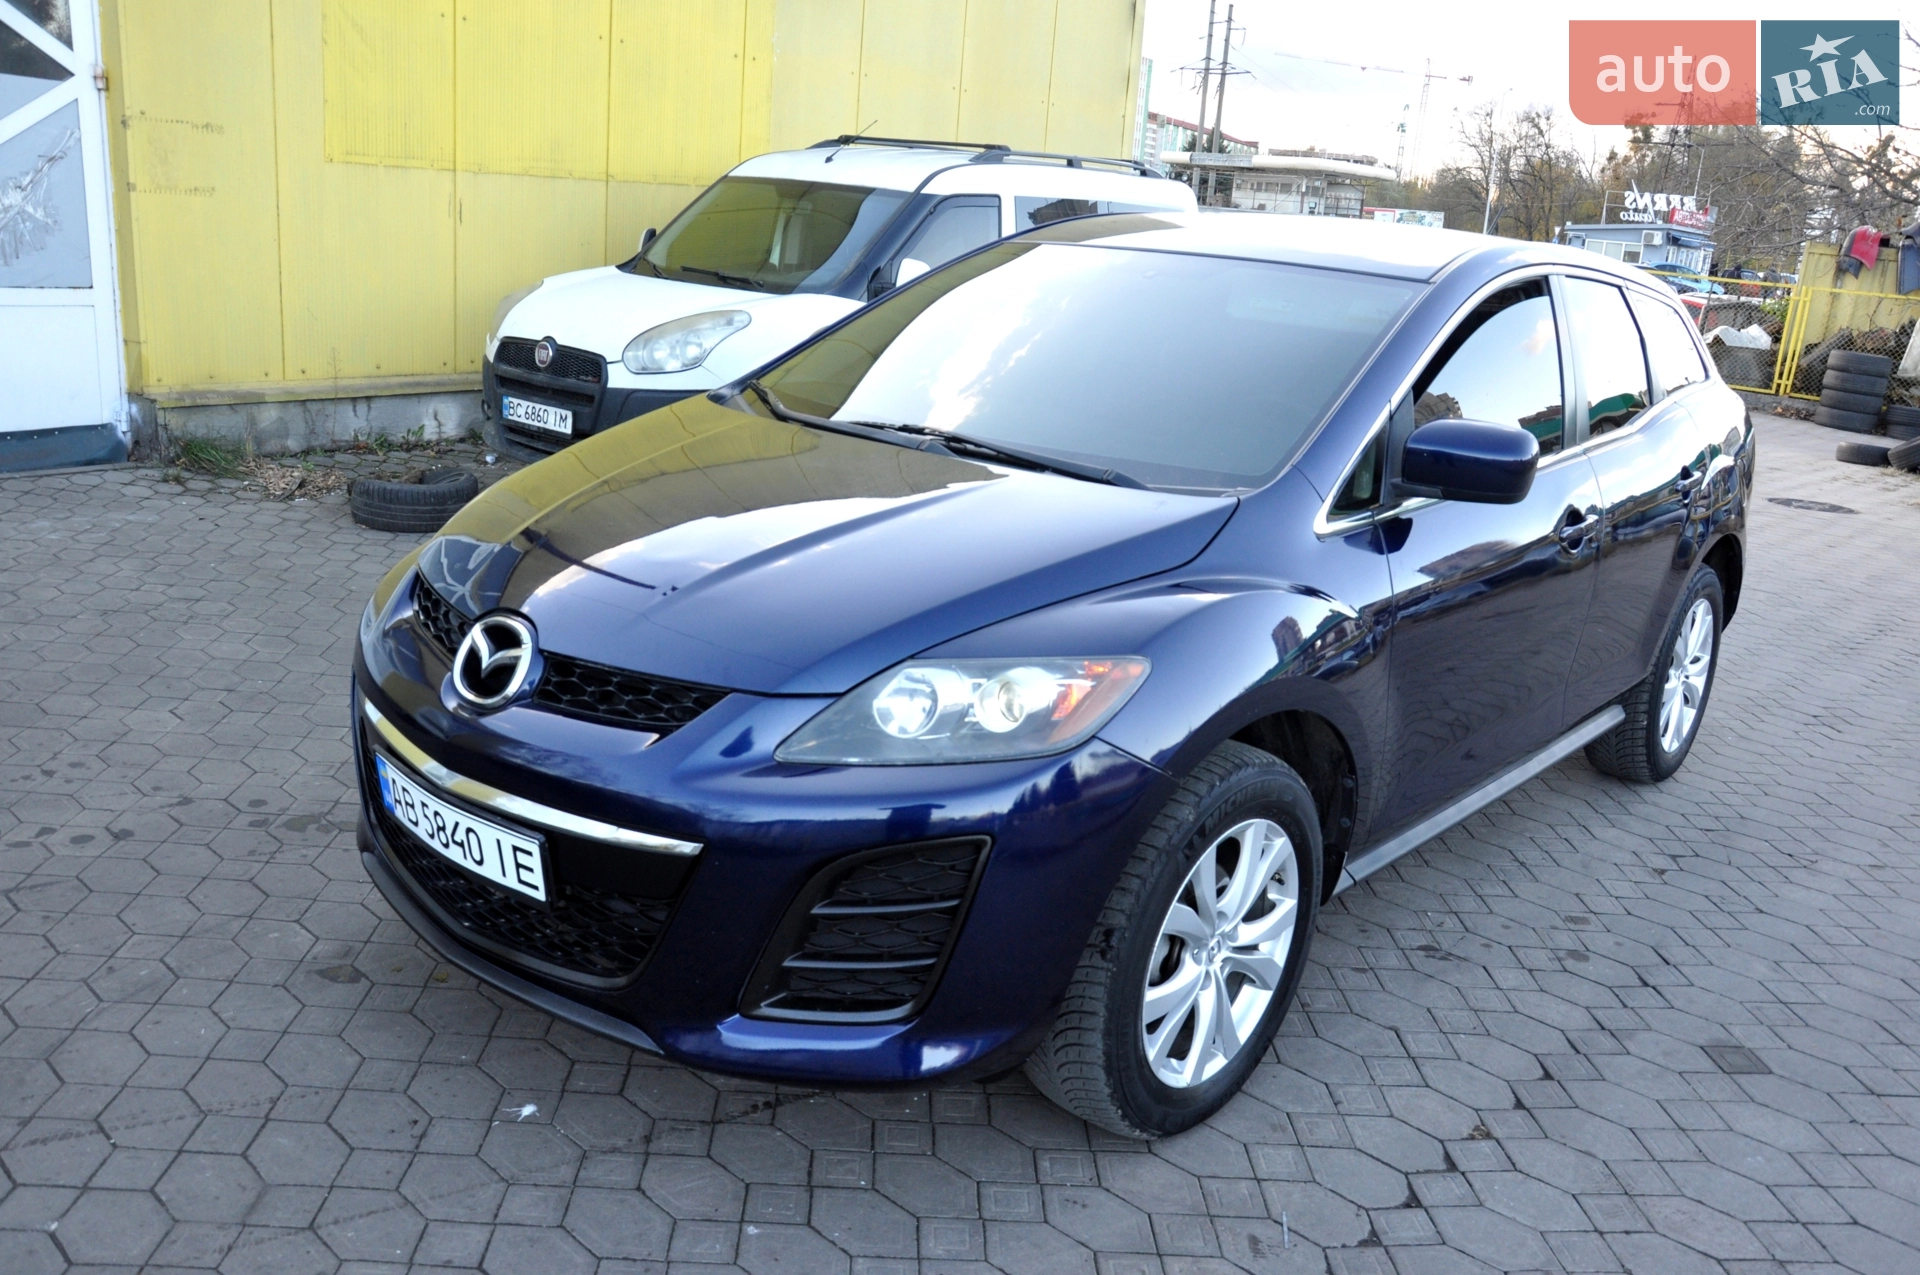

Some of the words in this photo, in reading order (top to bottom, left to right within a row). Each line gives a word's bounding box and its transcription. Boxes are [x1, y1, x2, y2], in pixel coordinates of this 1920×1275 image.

[508, 401, 523, 419] BC
[524, 404, 549, 425] 6860
[554, 410, 568, 430] IM
[391, 777, 419, 828] AB
[420, 800, 485, 867] 5840
[496, 838, 540, 892] IE
